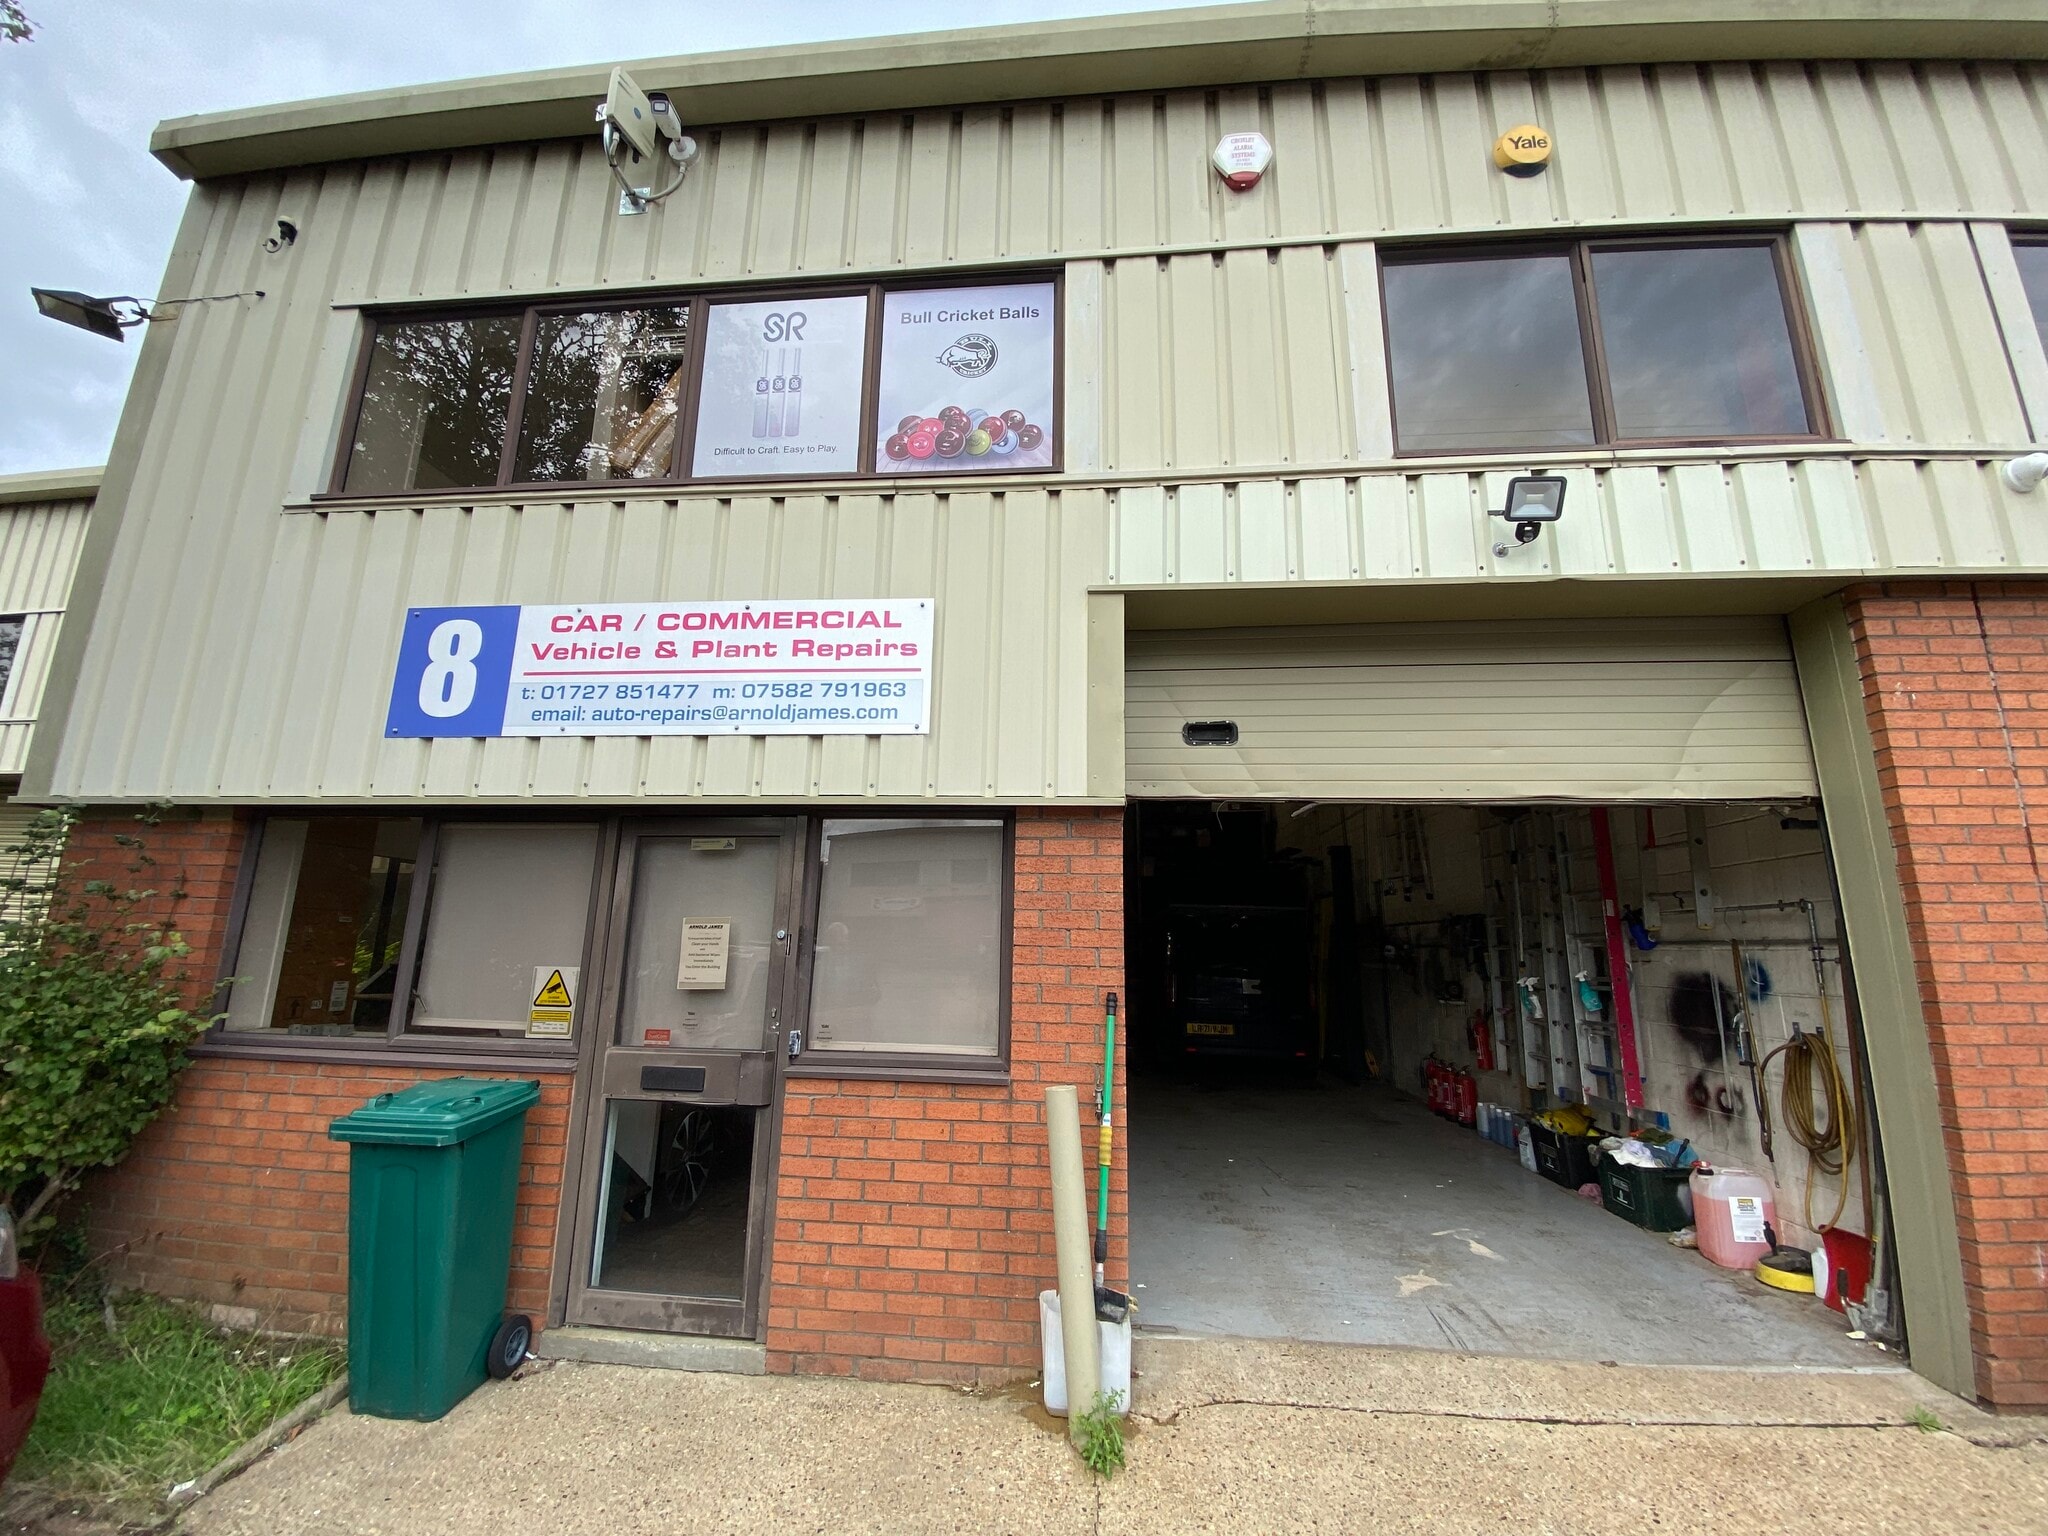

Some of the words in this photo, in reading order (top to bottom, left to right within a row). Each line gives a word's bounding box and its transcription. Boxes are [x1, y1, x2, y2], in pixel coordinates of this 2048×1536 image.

[1508, 135, 1548, 149] Yale
[901, 311, 931, 324] Bull
[938, 308, 994, 322] Cricket
[1000, 306, 1040, 319] Balls
[763, 312, 807, 342] SR
[714, 447, 745, 455] Difficult
[747, 447, 756, 455] to
[783, 445, 805, 455] Easy
[807, 445, 816, 453] to
[550, 615, 623, 634] CAR
[634, 614, 647, 631] /
[656, 610, 902, 631] COMMERCIAL
[531, 642, 641, 661] Vehicle
[654, 640, 678, 659] &
[691, 639, 777, 658] Plant
[791, 638, 918, 660] Repairs
[418, 619, 483, 718] 8
[521, 687, 536, 700] t:
[541, 684, 610, 700] 01727
[615, 684, 700, 699] 851477
[712, 687, 736, 699] m:
[742, 683, 813, 699] 07582
[820, 682, 907, 698] 791963
[531, 706, 586, 722] email:
[591, 703, 898, 725] auto-repairs@arnoldjames.com
